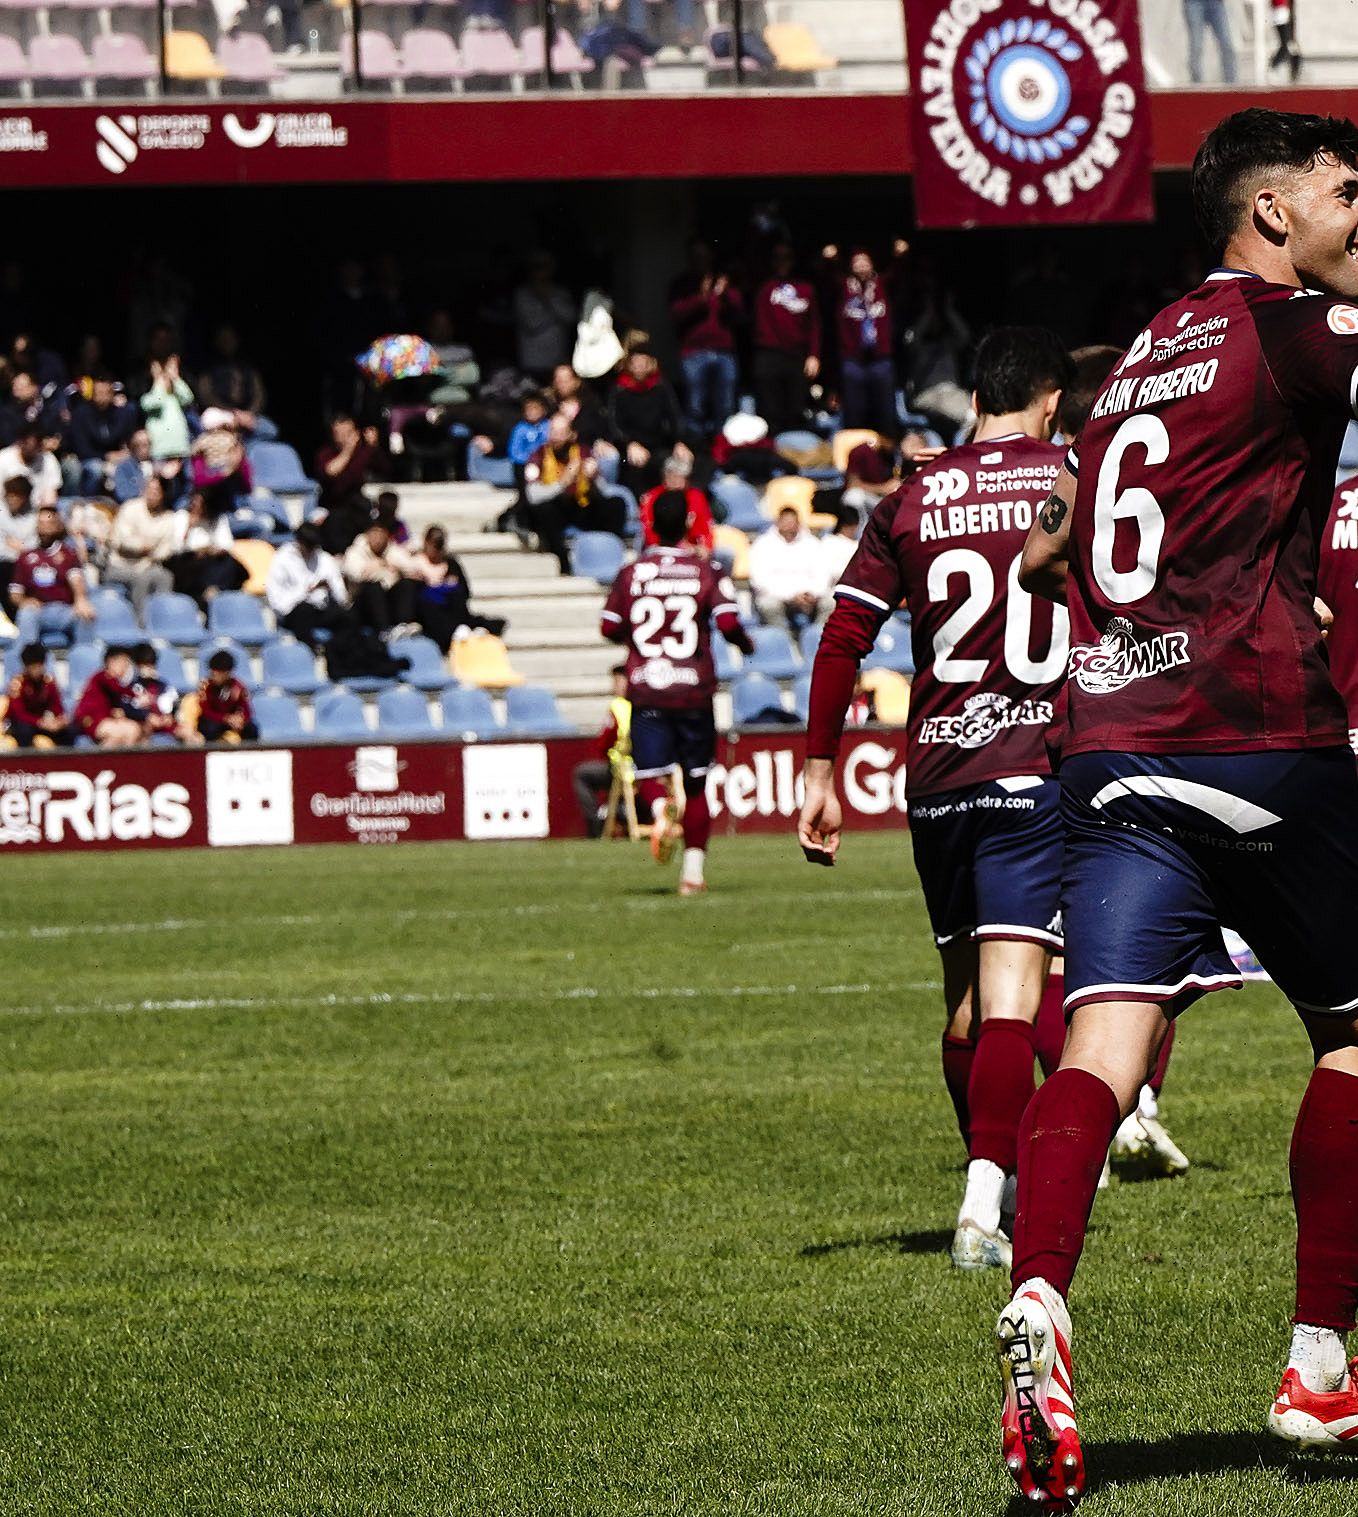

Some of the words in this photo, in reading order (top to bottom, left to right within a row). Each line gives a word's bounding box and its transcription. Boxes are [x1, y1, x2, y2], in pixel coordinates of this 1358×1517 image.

[1149, 333, 1226, 363] Pontevedra
[1154, 315, 1229, 349] Deputación
[1090, 377, 1141, 421] ALAIN
[1134, 358, 1219, 409] RIBEIRO
[975, 464, 1060, 483] Deputació
[920, 500, 1032, 543] ALBERTO
[1092, 413, 1170, 604] 6
[630, 595, 699, 660] 23
[927, 549, 1071, 685] 20
